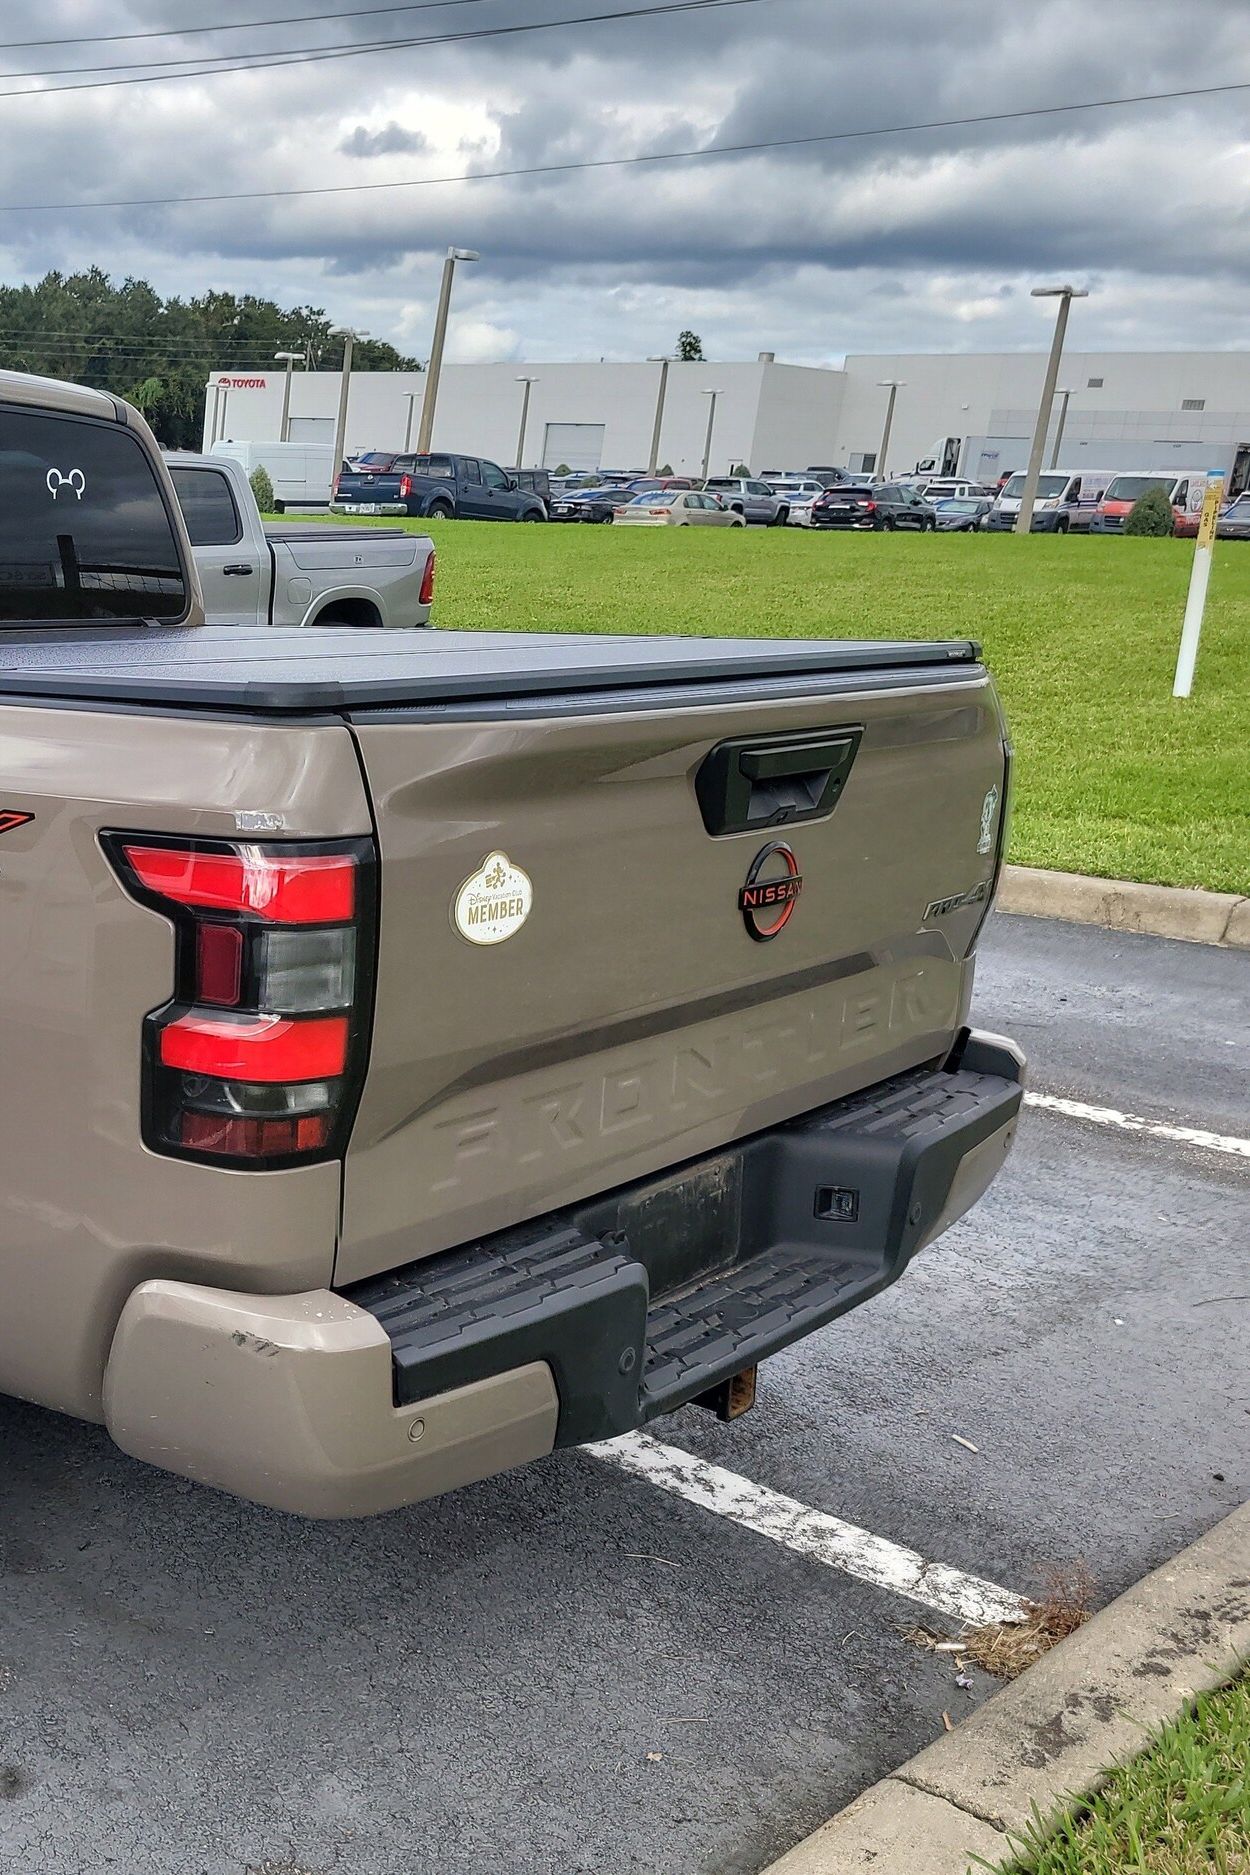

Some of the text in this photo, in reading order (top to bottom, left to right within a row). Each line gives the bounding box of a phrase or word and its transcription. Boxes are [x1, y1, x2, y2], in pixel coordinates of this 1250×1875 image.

[231, 379, 267, 389] TOYOTA
[743, 881, 802, 906] NISSAN
[468, 898, 524, 925] MEMBER
[430, 969, 946, 1192] FRONTIER
